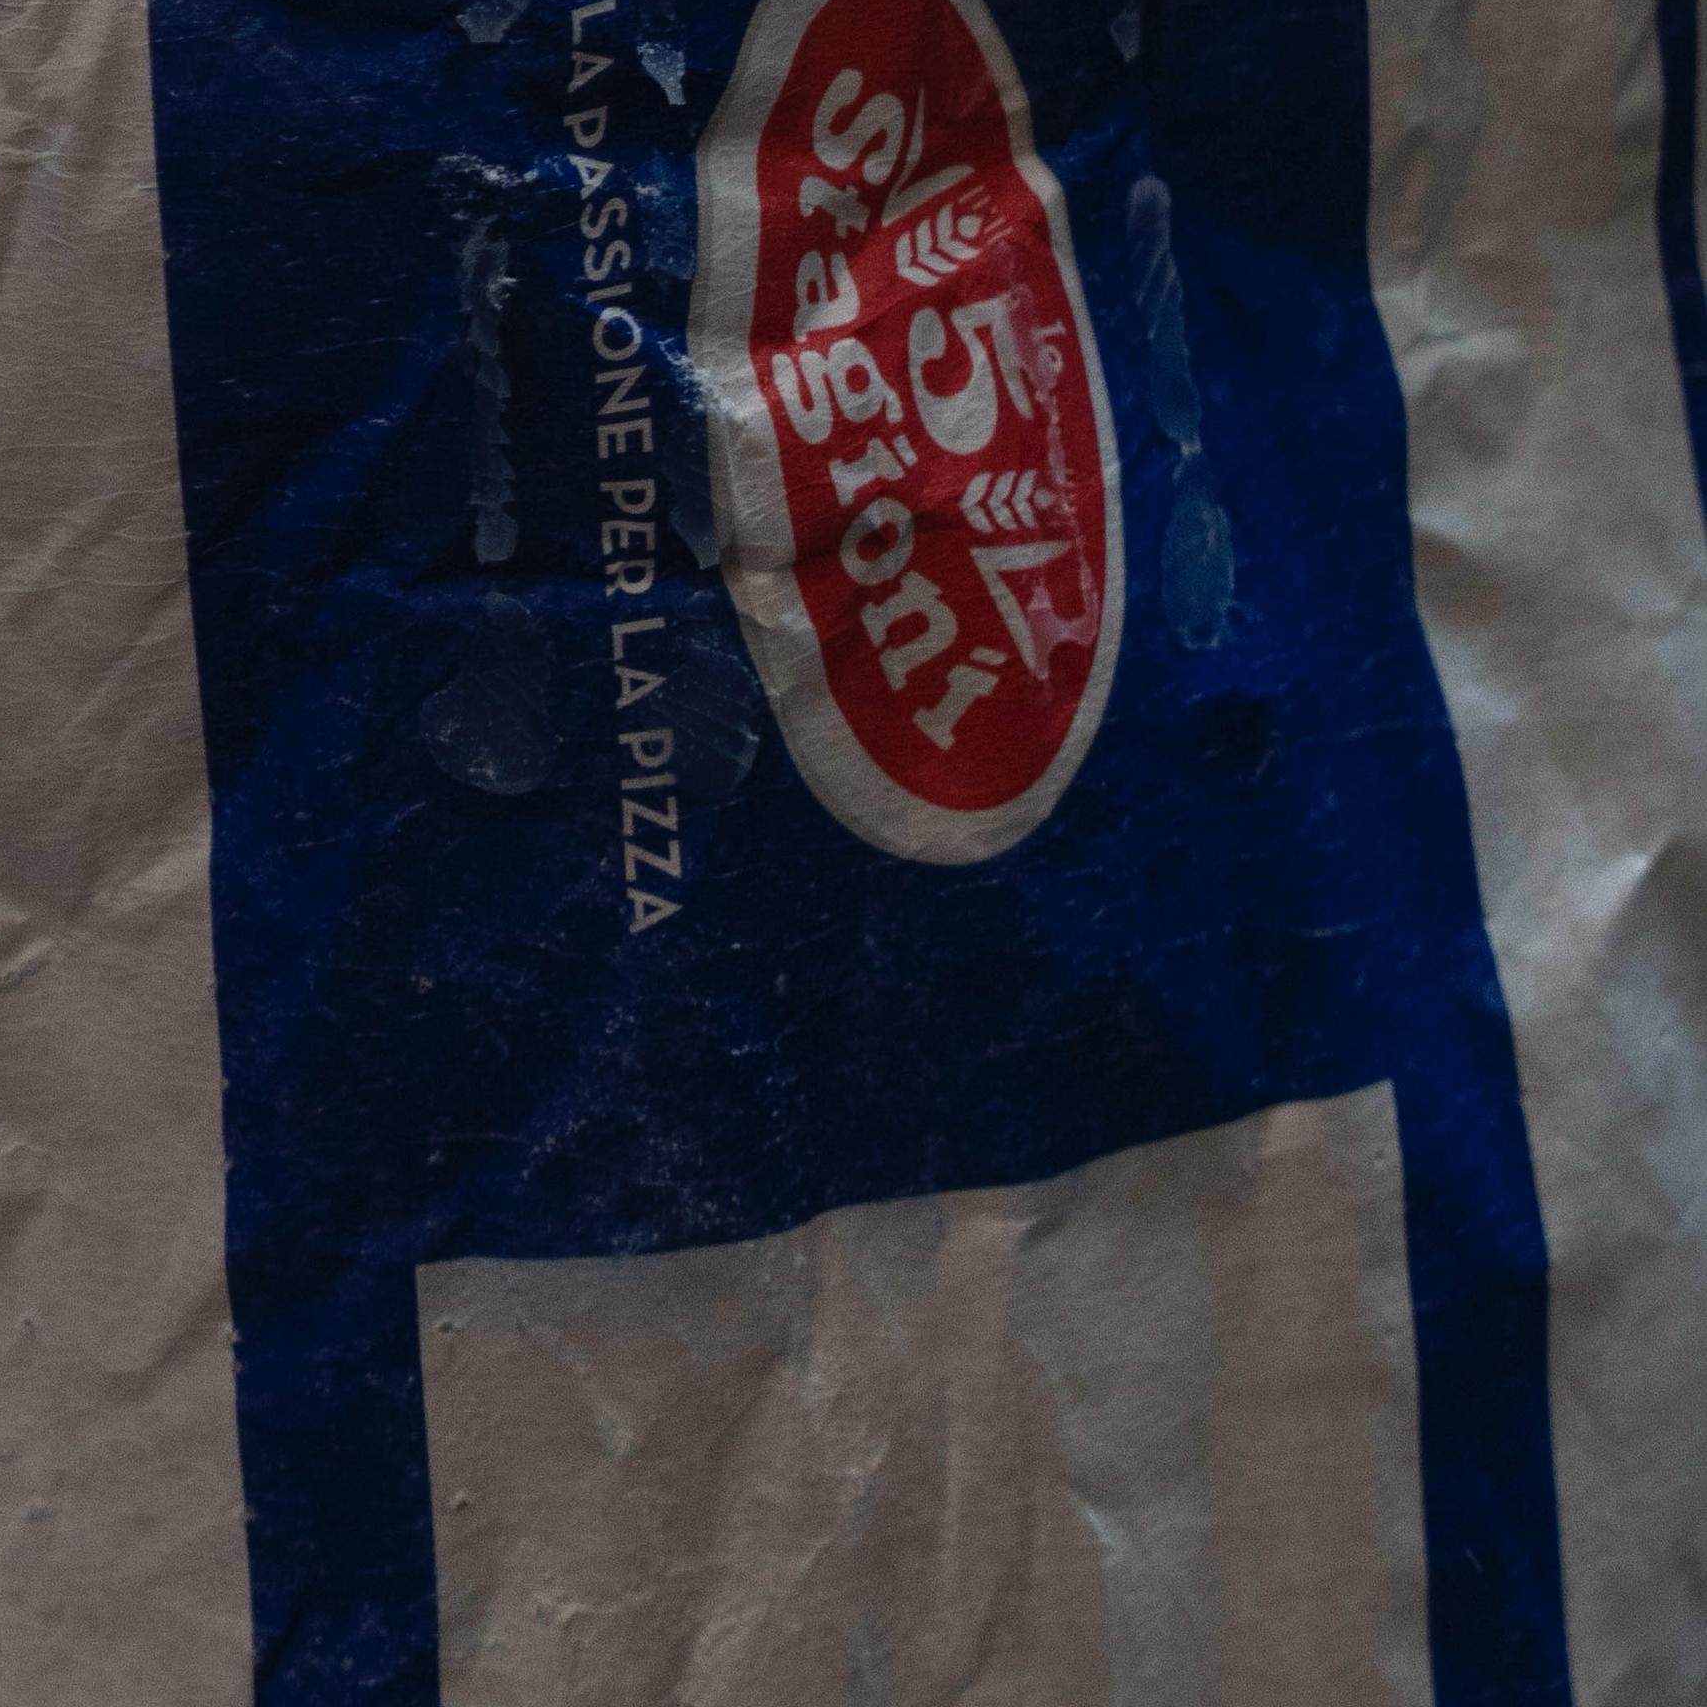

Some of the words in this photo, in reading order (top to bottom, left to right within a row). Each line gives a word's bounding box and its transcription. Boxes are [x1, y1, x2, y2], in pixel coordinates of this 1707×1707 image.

[561, 111, 655, 461] PASSIONE
[906, 293, 1039, 456] 5
[770, 66, 1011, 754] Stagioni
[596, 478, 659, 597] PER
[610, 617, 666, 714] LA
[616, 728, 684, 935] PIZZA
